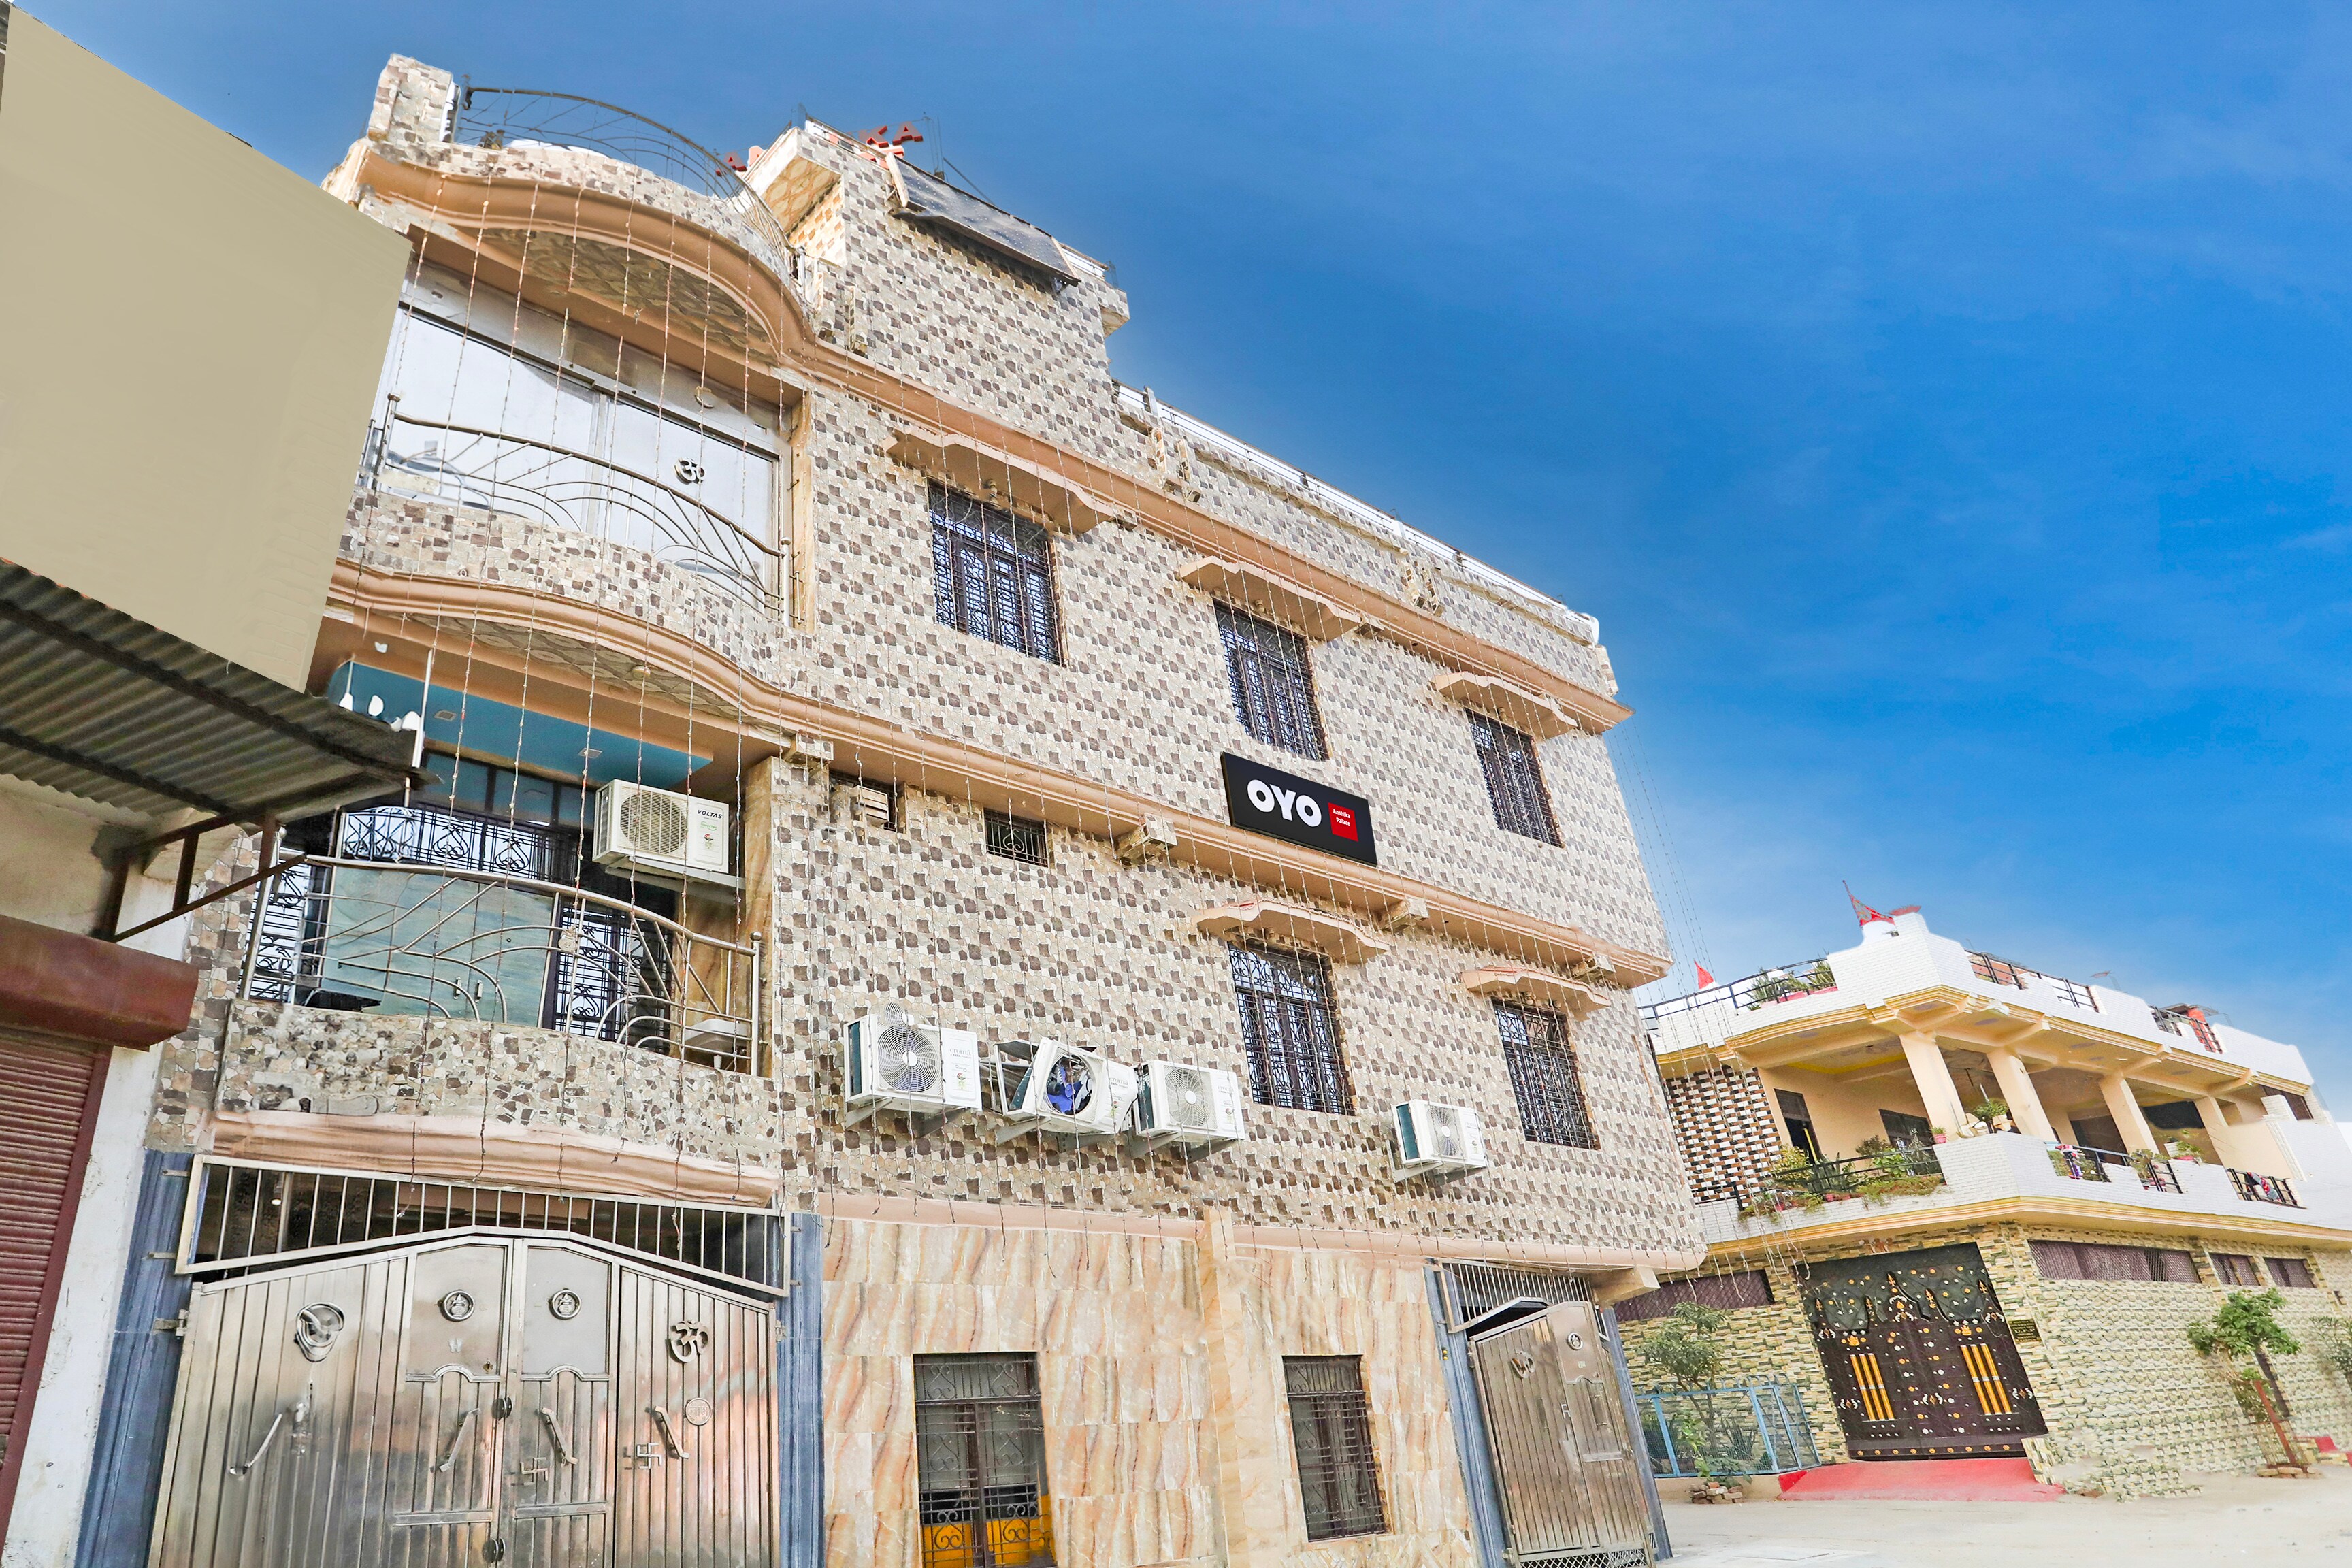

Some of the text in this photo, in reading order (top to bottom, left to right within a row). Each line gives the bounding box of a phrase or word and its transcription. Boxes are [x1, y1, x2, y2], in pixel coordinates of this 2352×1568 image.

[1247, 779, 1322, 827] OYO
[698, 809, 723, 819] VOLTAS
[1333, 808, 1351, 819] Anshika
[1336, 817, 1351, 827] Palace
